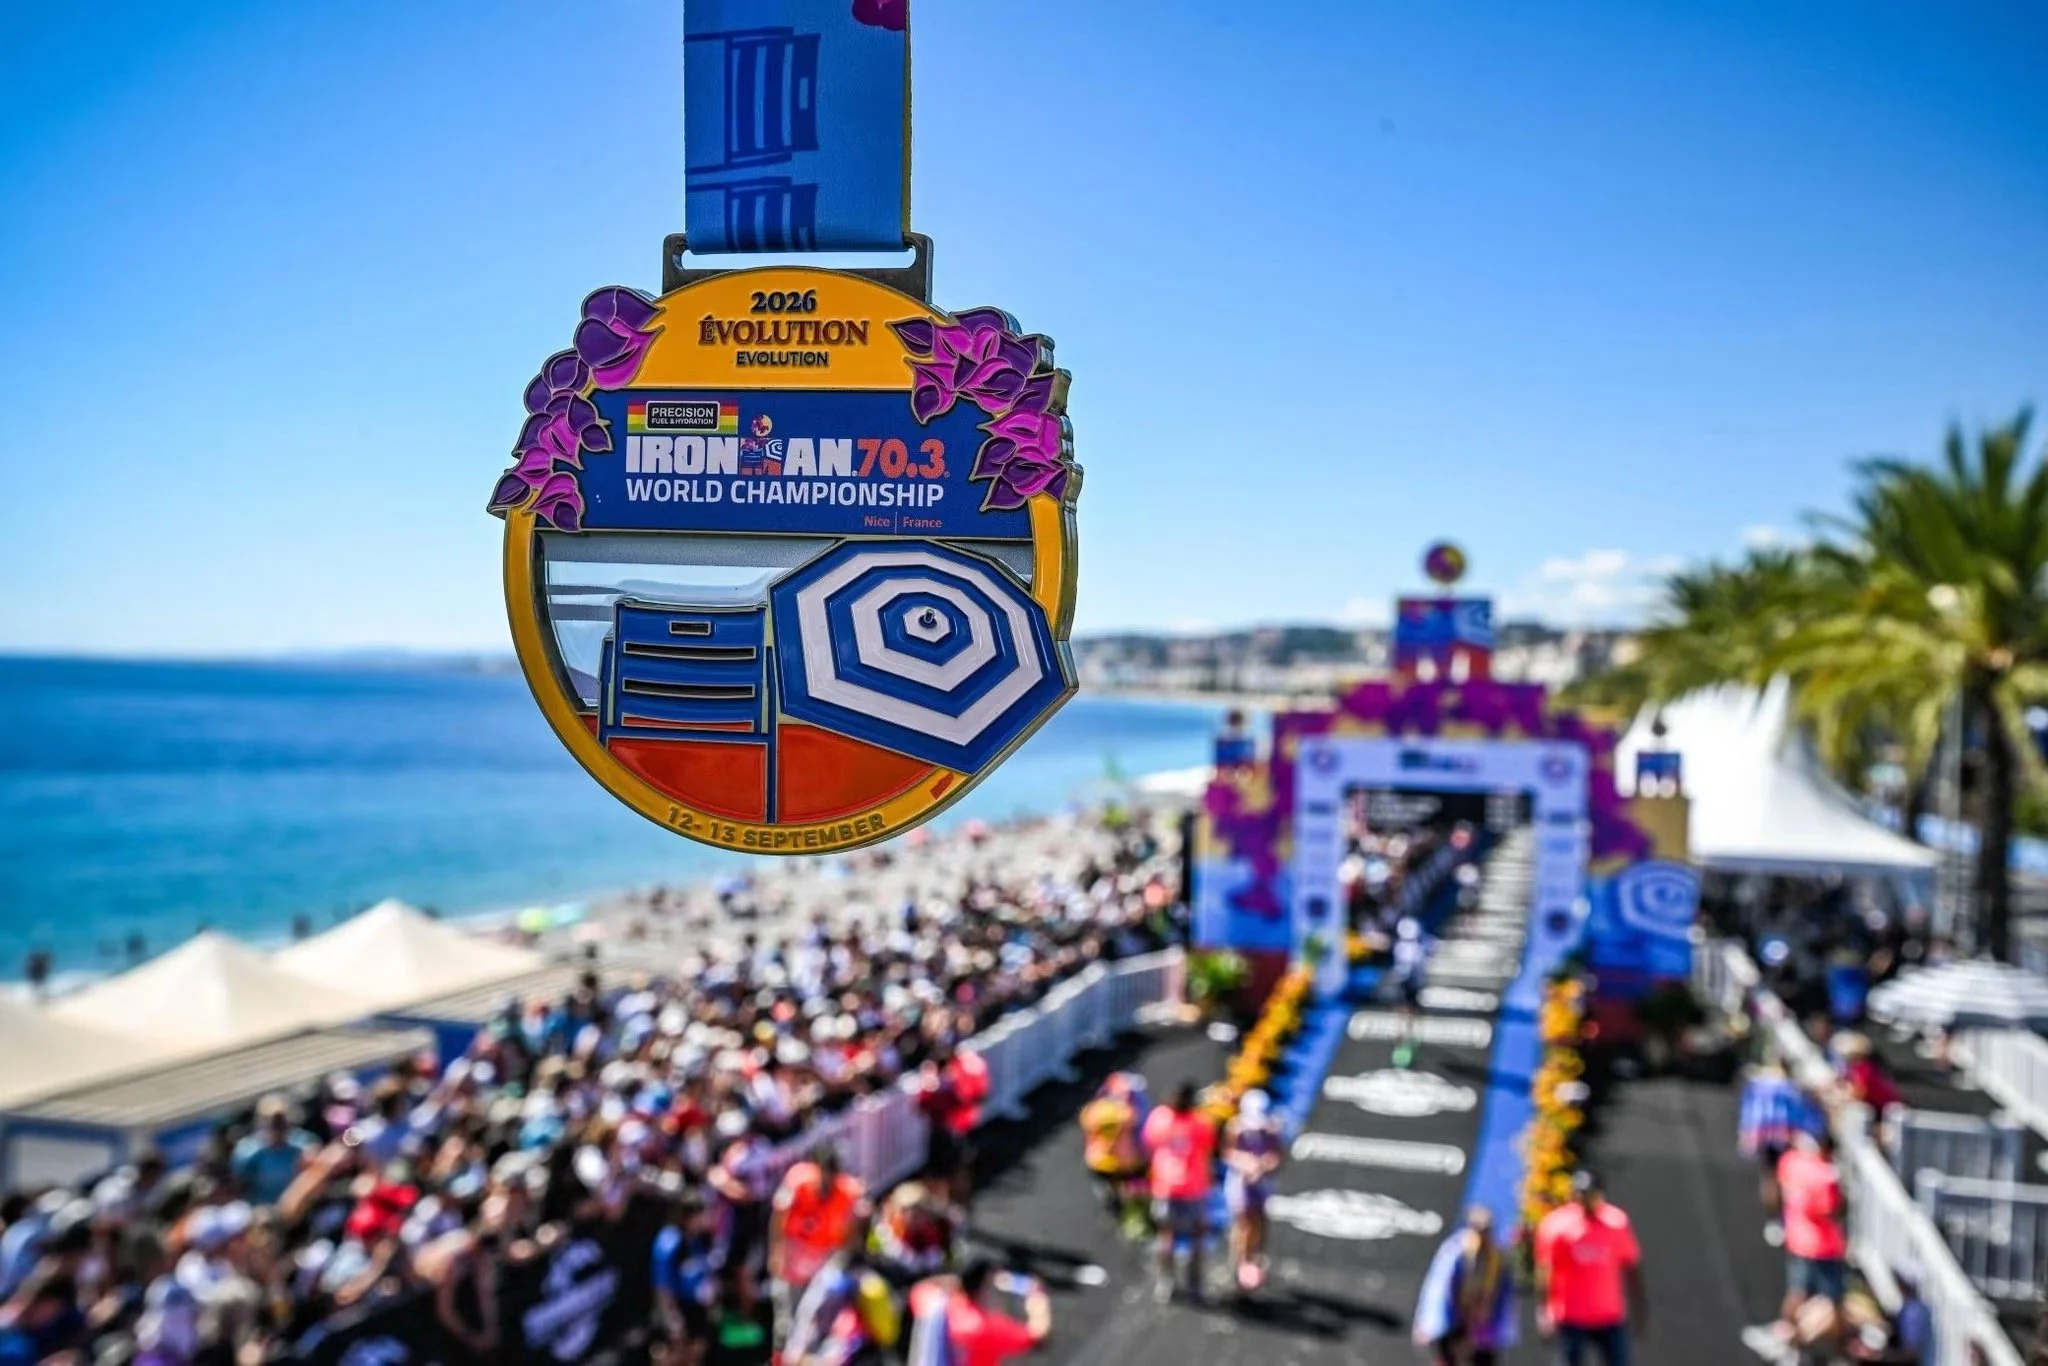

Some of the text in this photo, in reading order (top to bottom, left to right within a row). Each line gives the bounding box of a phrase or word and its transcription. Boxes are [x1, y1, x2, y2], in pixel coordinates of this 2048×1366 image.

[750, 290, 817, 313] 2026
[698, 315, 869, 345] ÉVOLUTION
[736, 351, 828, 367] EVOLUTION
[651, 407, 714, 418] PRECISION
[626, 478, 944, 507] WORLD CHAMPIONSHIP
[864, 515, 943, 528] Nice France
[710, 821, 736, 843] 13
[743, 813, 885, 847] SEPTEMBER
